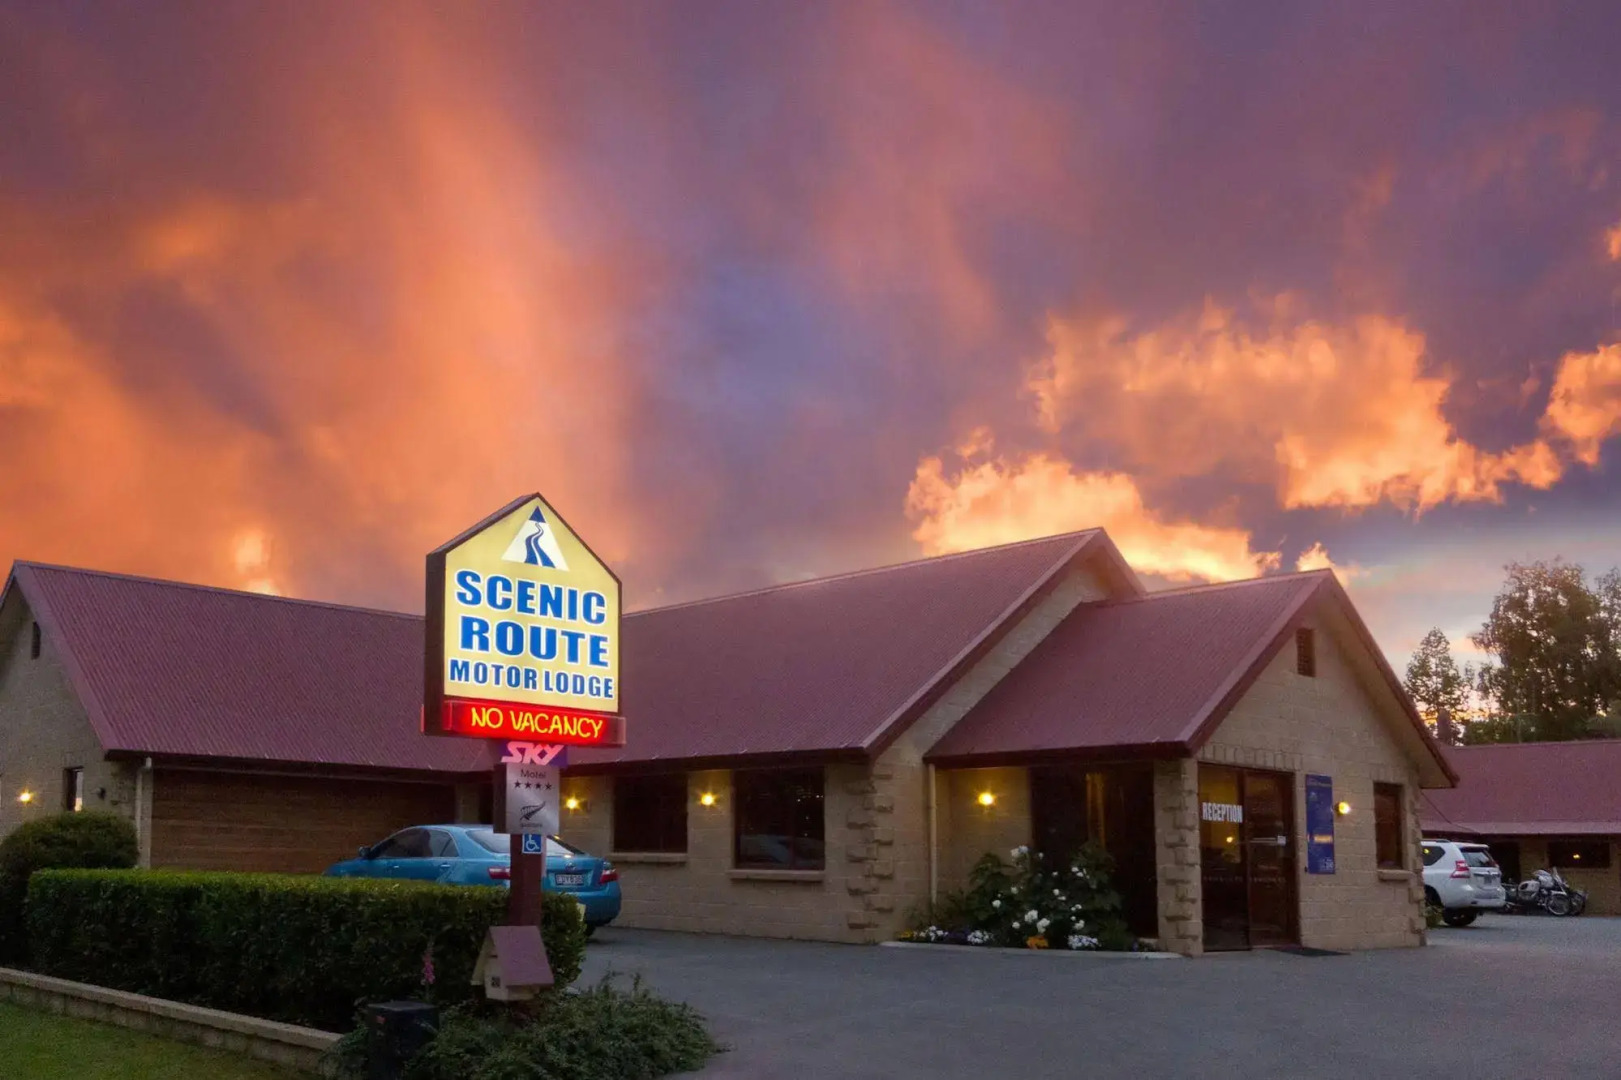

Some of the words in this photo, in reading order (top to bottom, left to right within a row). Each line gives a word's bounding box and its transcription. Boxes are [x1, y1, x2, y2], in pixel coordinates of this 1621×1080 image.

[456, 571, 605, 624] SCENIC
[461, 616, 608, 666] ROUTE
[450, 659, 537, 689] MOTOR
[544, 671, 613, 698] LODGE
[471, 707, 503, 729] NO
[511, 711, 603, 737] VACANCY
[501, 741, 564, 765] SKY
[520, 769, 546, 779] Motel
[1202, 802, 1243, 823] RECEPTION
